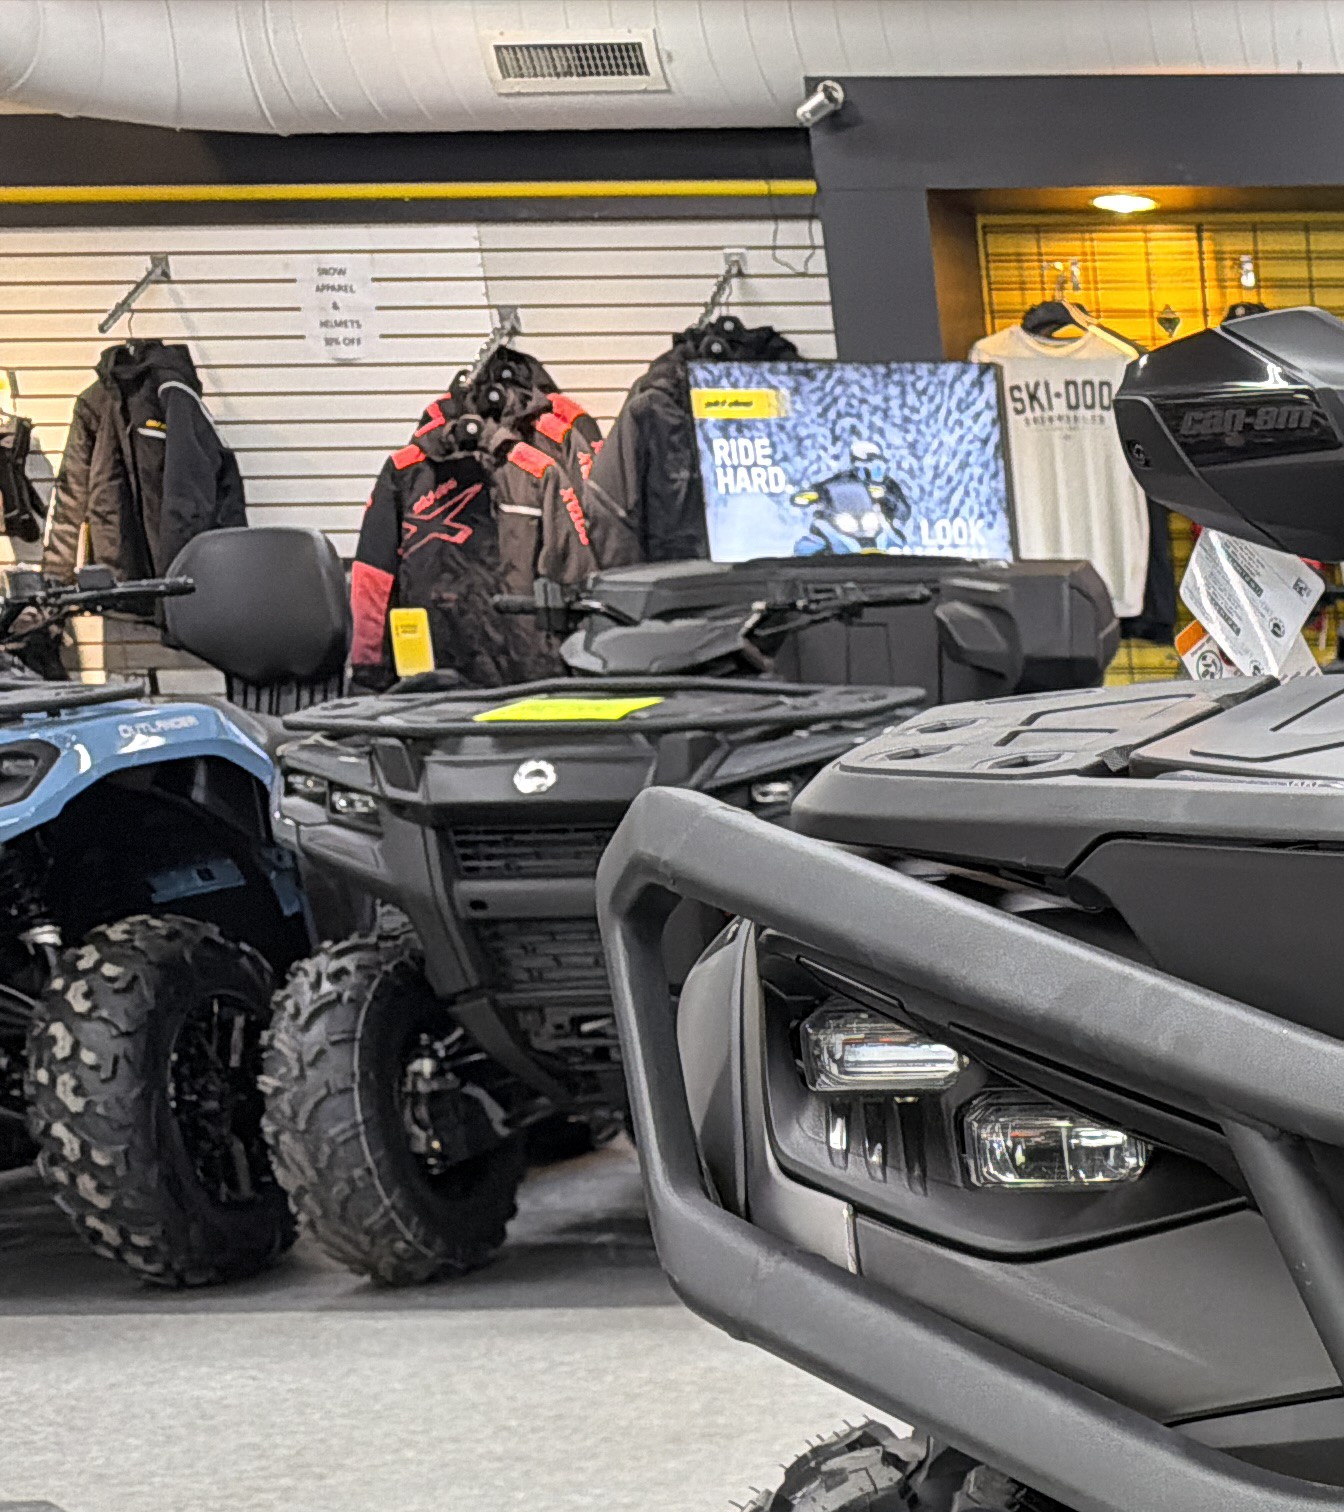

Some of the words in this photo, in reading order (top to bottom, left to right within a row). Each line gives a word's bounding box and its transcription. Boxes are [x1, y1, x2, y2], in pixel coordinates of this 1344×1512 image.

[1009, 379, 1113, 416] SKI-DOO
[1178, 404, 1315, 437] can-am
[711, 437, 773, 468] RIDE
[715, 466, 795, 495] HARD.
[919, 517, 986, 546] LOOK
